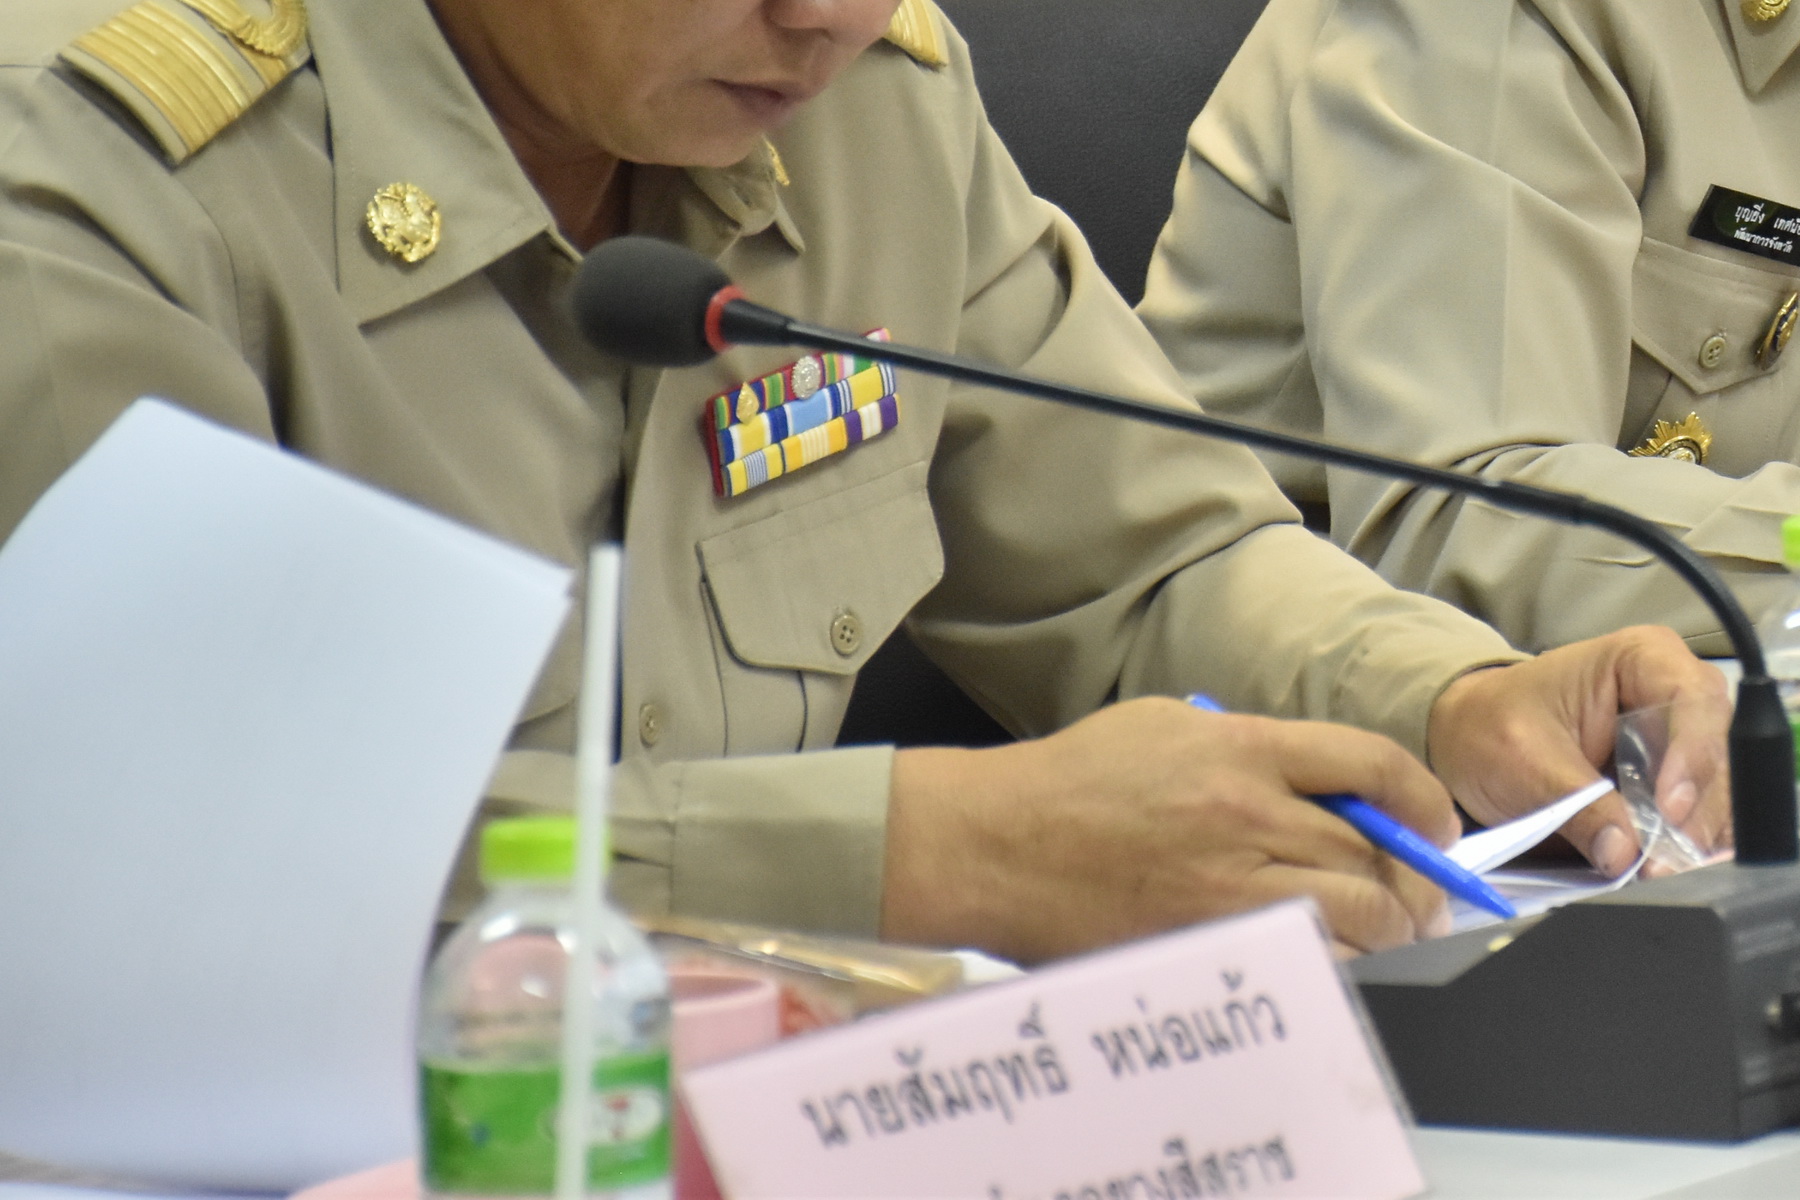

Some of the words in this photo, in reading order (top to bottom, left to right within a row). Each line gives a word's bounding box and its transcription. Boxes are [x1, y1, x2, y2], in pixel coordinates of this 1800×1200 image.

[803, 1001, 1071, 1148] นายสัมฤทธิ์
[1090, 969, 1288, 1078] หน่อแก้ว
